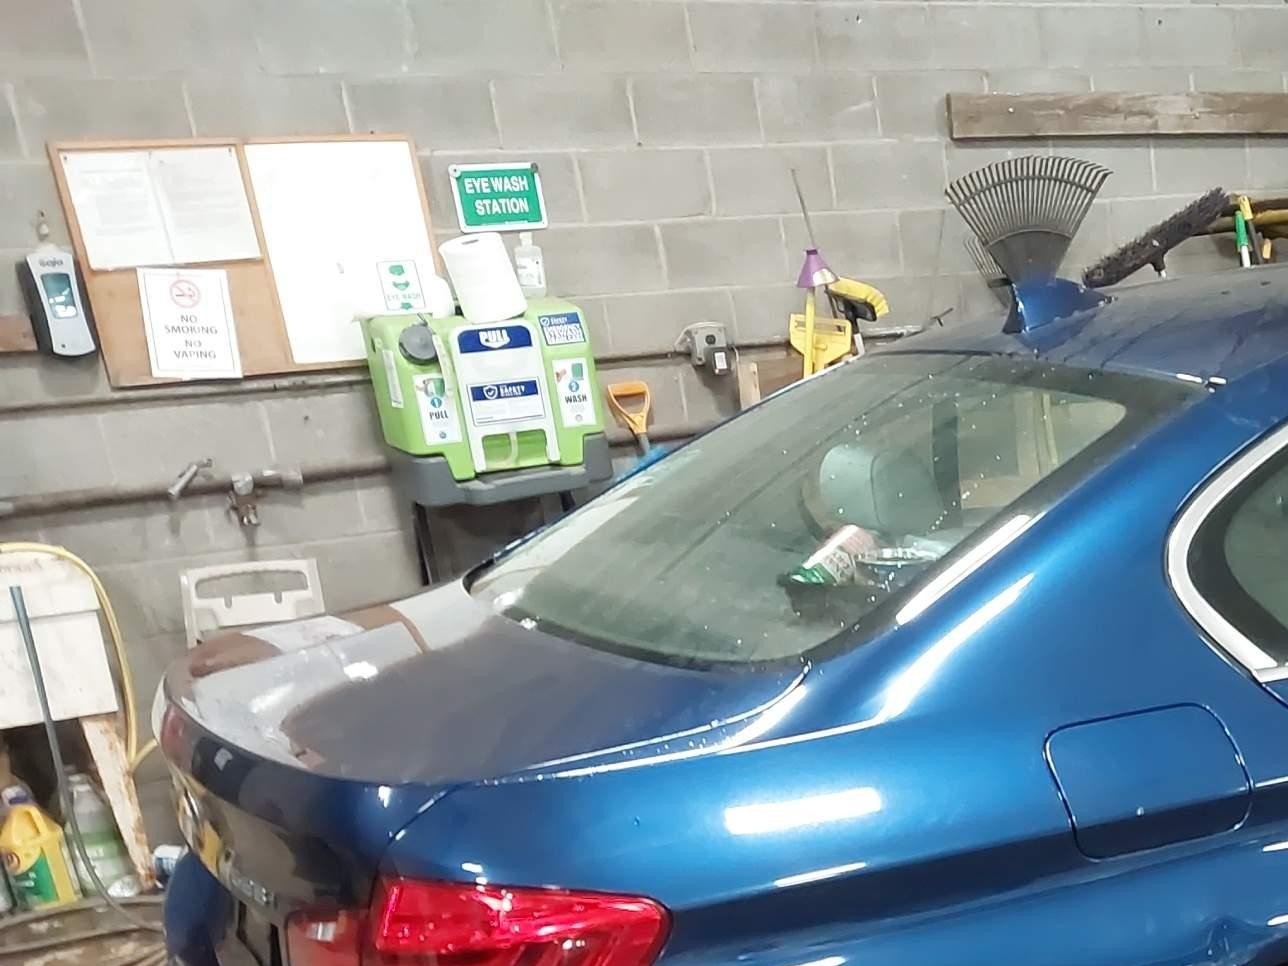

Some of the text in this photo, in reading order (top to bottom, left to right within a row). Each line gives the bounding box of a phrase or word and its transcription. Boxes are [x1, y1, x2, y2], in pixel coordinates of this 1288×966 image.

[464, 175, 529, 194] EYE WASH
[474, 197, 529, 216] STATION
[180, 314, 198, 324] NO
[164, 324, 218, 335] SMOKING
[478, 329, 509, 343] PULL
[184, 339, 202, 349] NO
[172, 350, 217, 360] VAPING
[564, 393, 588, 404] WASH
[429, 410, 449, 420] PULL
